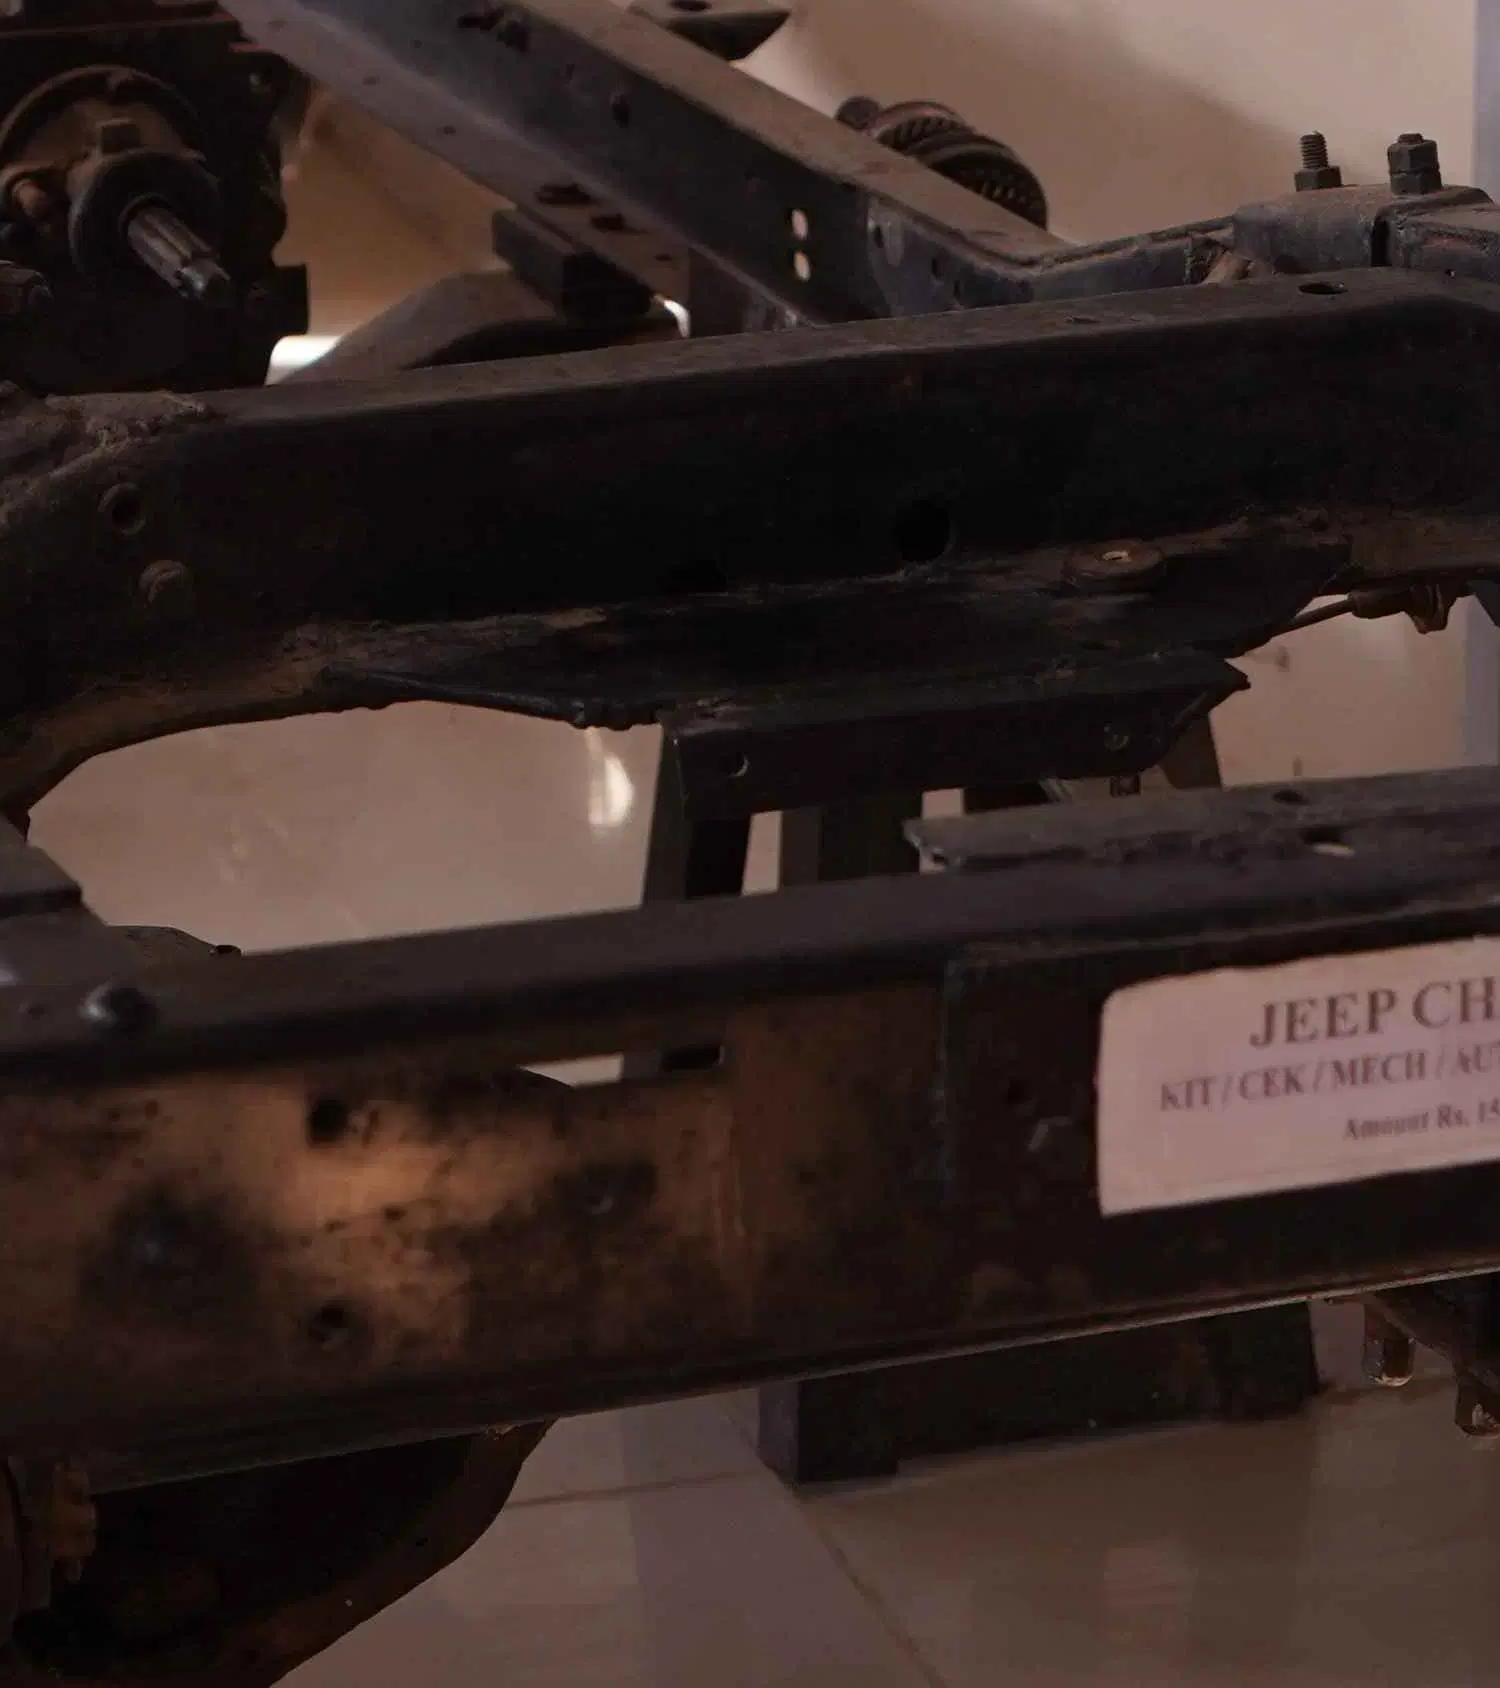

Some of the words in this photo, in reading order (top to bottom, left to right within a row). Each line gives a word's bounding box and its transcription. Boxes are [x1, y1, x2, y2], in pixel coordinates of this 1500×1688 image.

[1248, 987, 1398, 1050] JEEP
[1160, 1075, 1218, 1112] KIT
[1239, 1063, 1305, 1101] CEK
[1331, 1050, 1427, 1088] MECH
[1344, 1111, 1430, 1141] Amount
